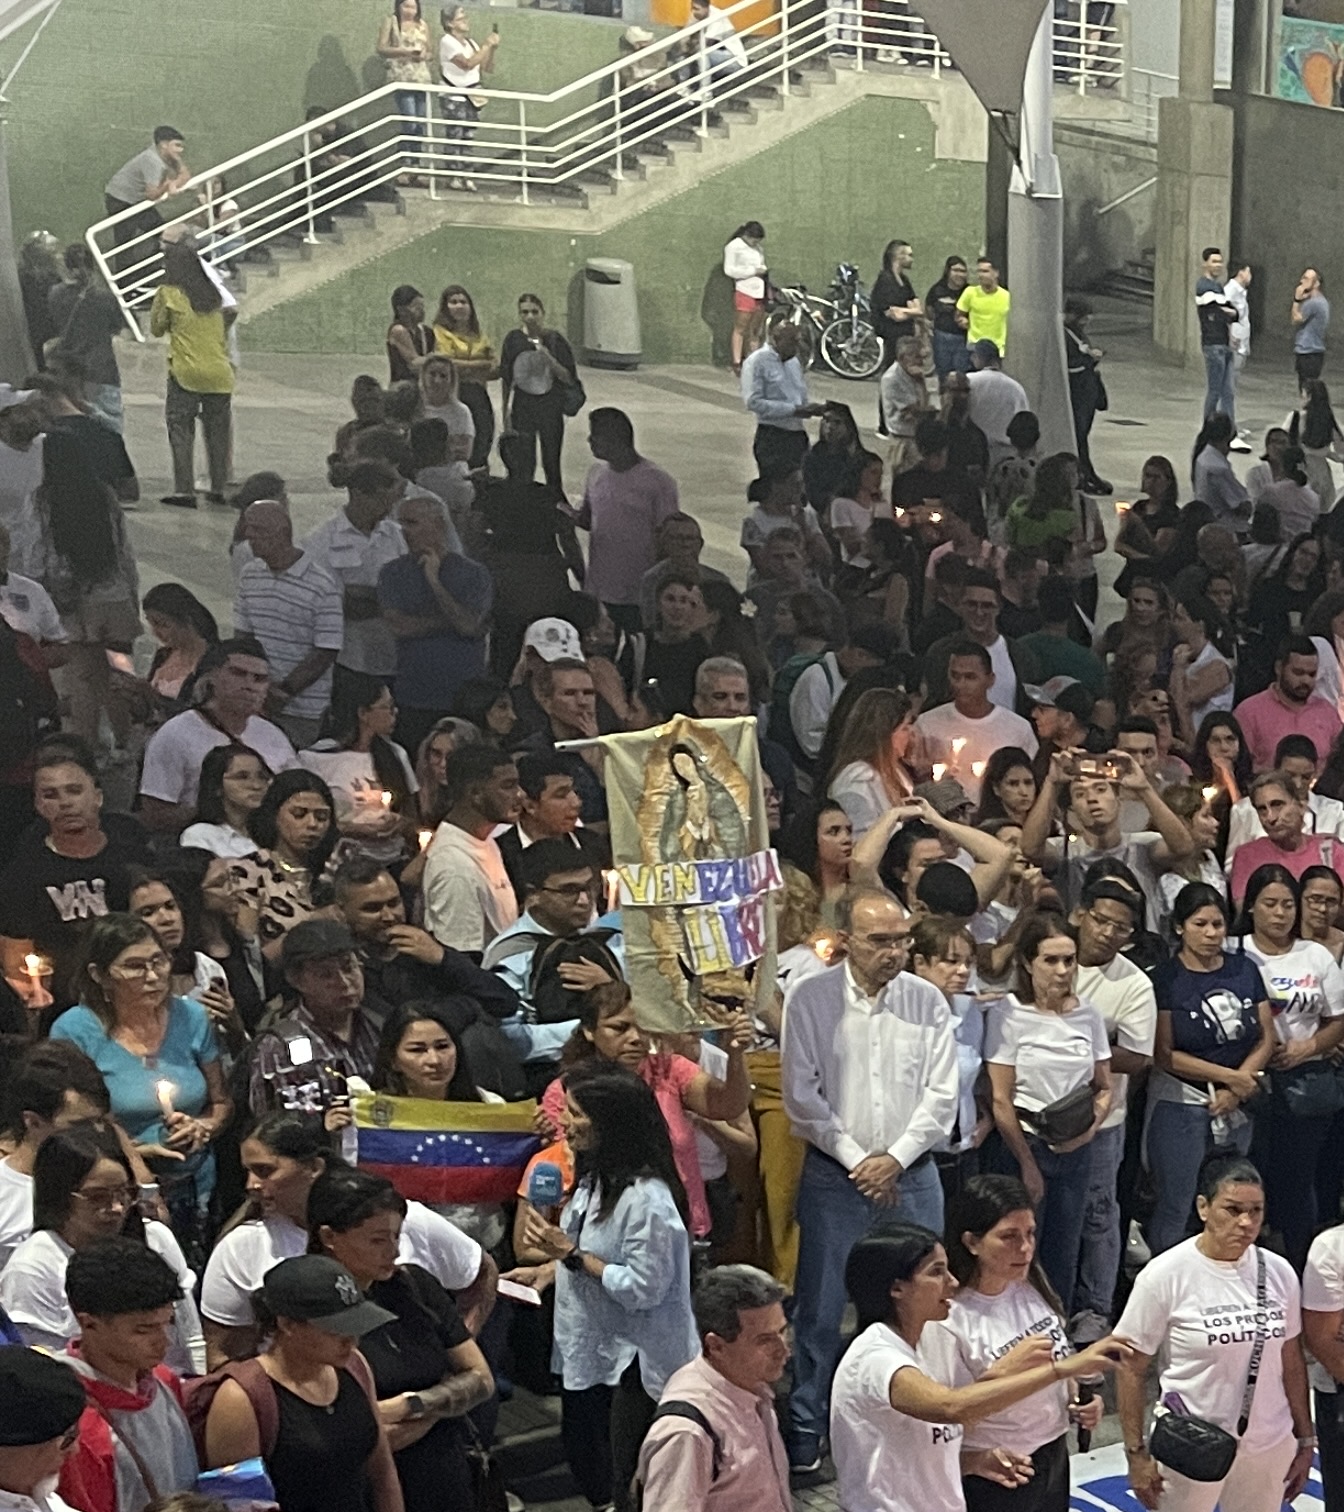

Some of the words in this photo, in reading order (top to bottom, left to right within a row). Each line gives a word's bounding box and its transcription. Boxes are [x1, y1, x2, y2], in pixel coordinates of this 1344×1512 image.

[1203, 1317, 1233, 1330] LOS
[1235, 1309, 1285, 1327] PREOS
[1207, 1322, 1287, 1346] POLÍTCOS
